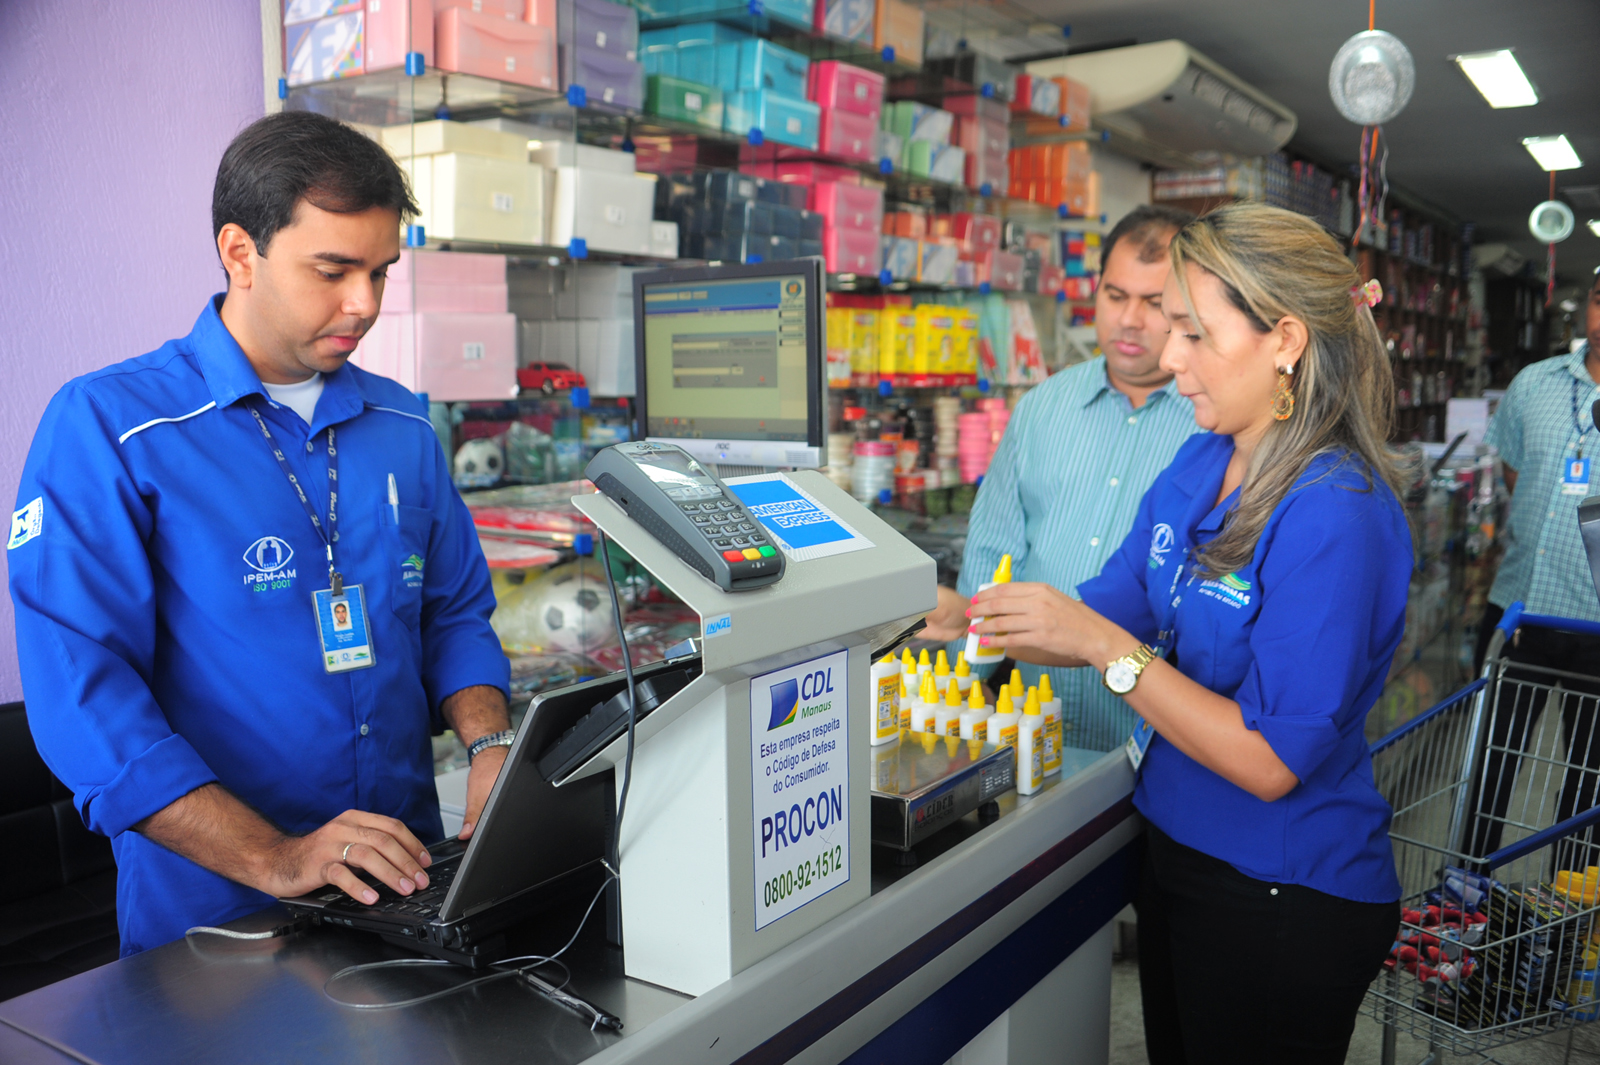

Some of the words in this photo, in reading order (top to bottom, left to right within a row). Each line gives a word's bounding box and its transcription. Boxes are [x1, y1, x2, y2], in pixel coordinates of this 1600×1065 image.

[715, 442, 731, 450] AOC
[748, 499, 817, 518] AMERICAN
[771, 511, 833, 529] EXPRESS
[243, 568, 297, 586] IPEM-AM
[253, 582, 267, 592] ISO
[271, 579, 291, 590] 9001
[705, 616, 731, 635] INNAL
[801, 667, 834, 701] CDL
[801, 701, 832, 719] Manaus
[760, 742, 778, 758] Esta
[779, 730, 811, 750] empresa
[812, 718, 840, 738] respeita
[766, 766, 771, 776] o
[773, 754, 800, 773] Código
[801, 748, 811, 762] de
[812, 740, 836, 758] Defesa
[773, 779, 783, 794] do
[784, 762, 830, 788] Consumidor.
[761, 784, 842, 858] PROCON
[764, 844, 842, 908] 0800-92-1512
